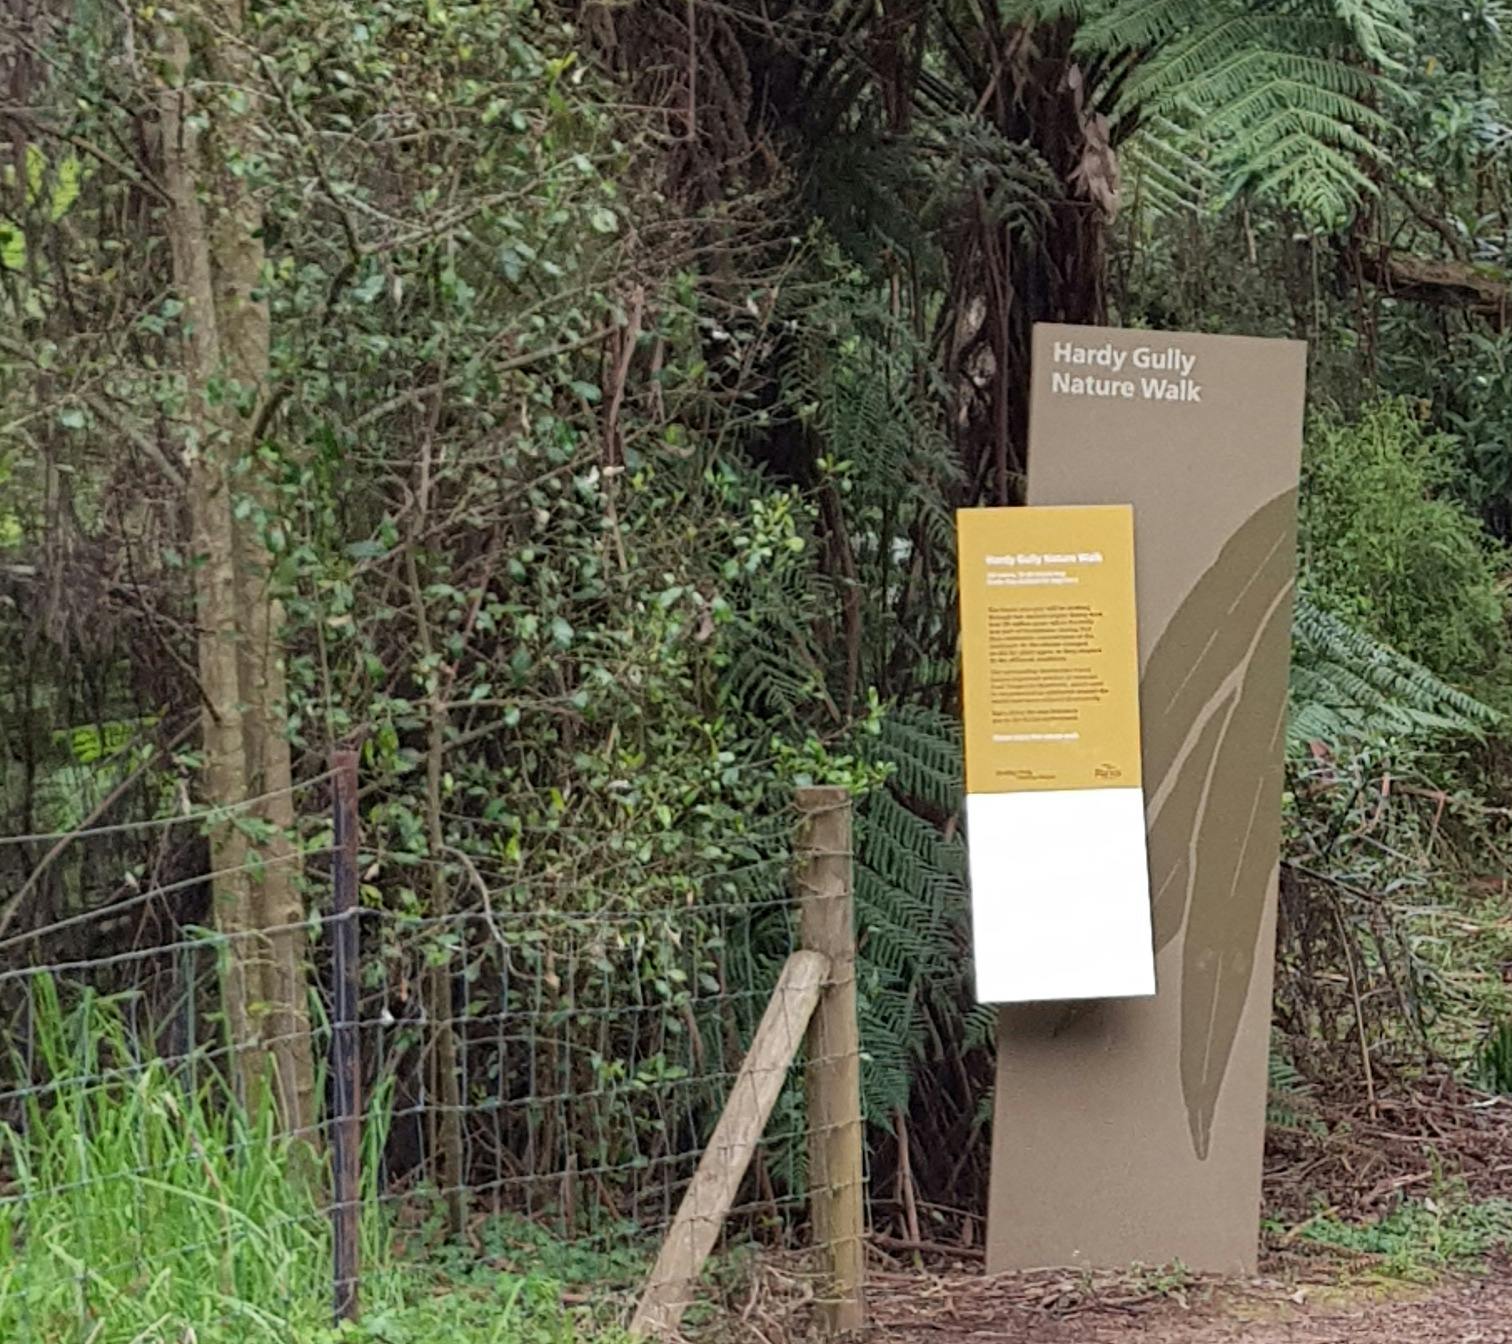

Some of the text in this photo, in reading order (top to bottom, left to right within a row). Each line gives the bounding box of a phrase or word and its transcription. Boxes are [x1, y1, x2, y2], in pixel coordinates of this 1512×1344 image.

[1053, 341, 1196, 376] Hardy Gully
[1051, 372, 1202, 402] Nature Walk
